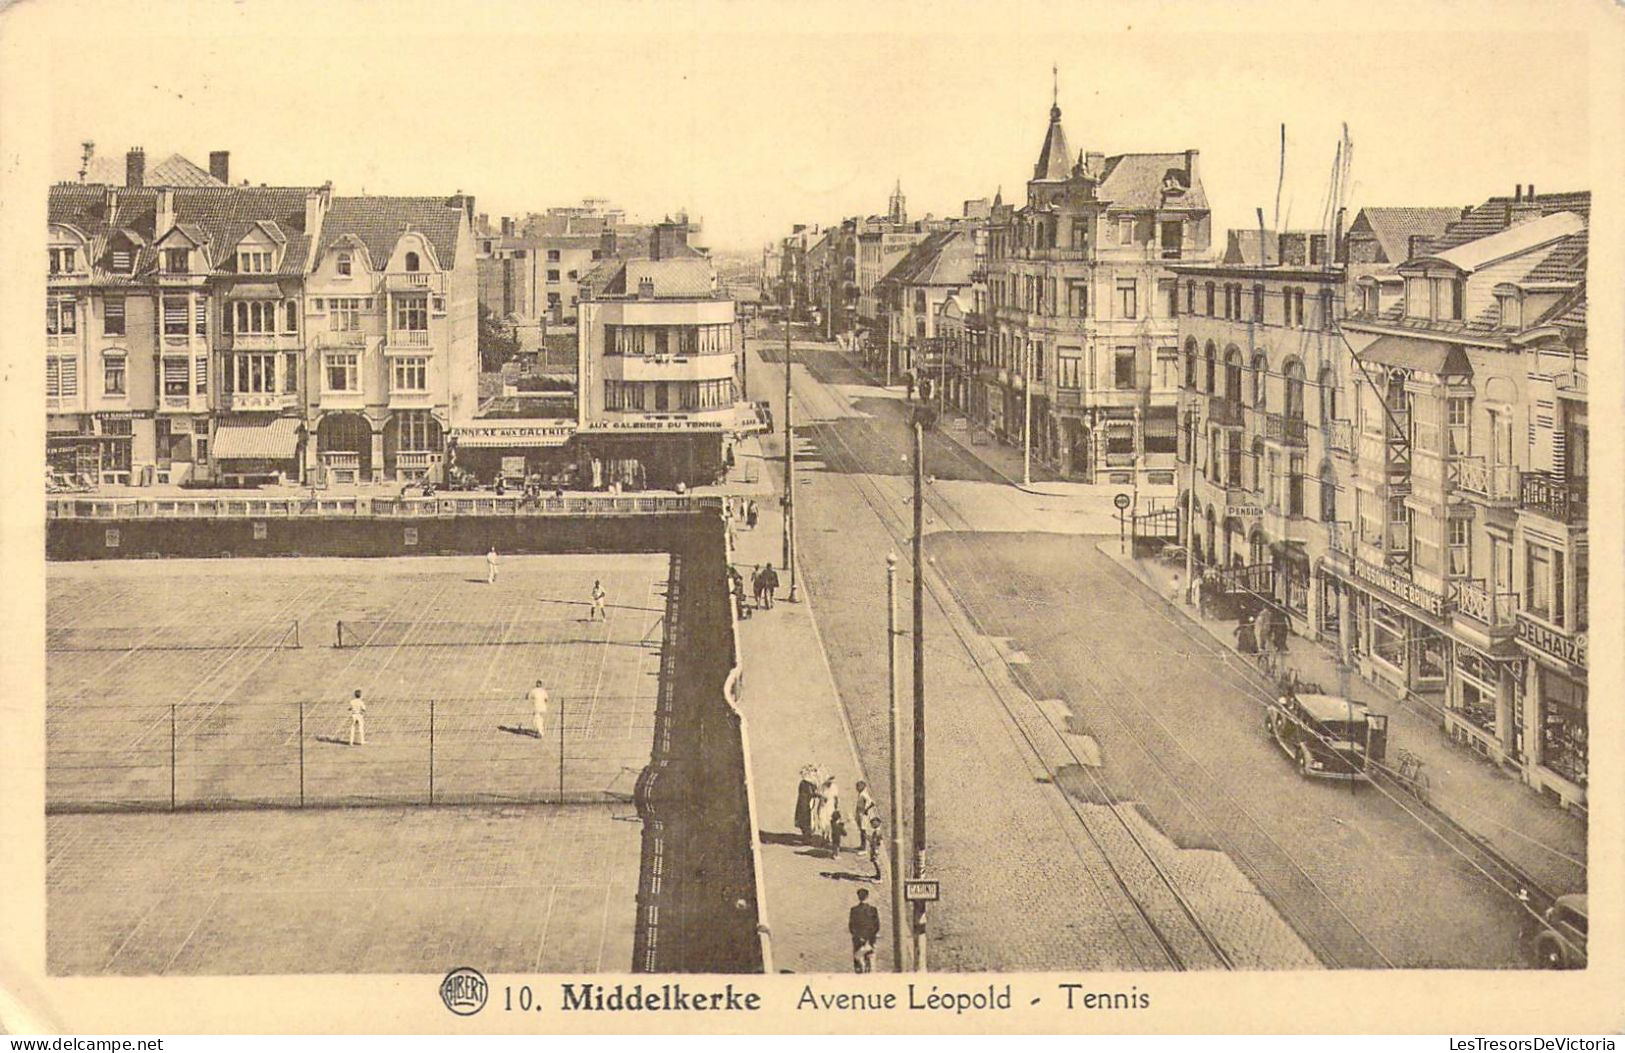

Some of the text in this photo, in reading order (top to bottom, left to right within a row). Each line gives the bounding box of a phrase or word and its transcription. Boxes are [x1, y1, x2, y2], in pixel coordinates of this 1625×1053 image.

[613, 422, 664, 430] GALERIES
[686, 421, 722, 429] TENNIS
[454, 428, 496, 437] ANNEXE
[520, 428, 577, 437] GALERIES
[1228, 506, 1264, 517] PENSION
[1517, 619, 1586, 665] DELHAIZE
